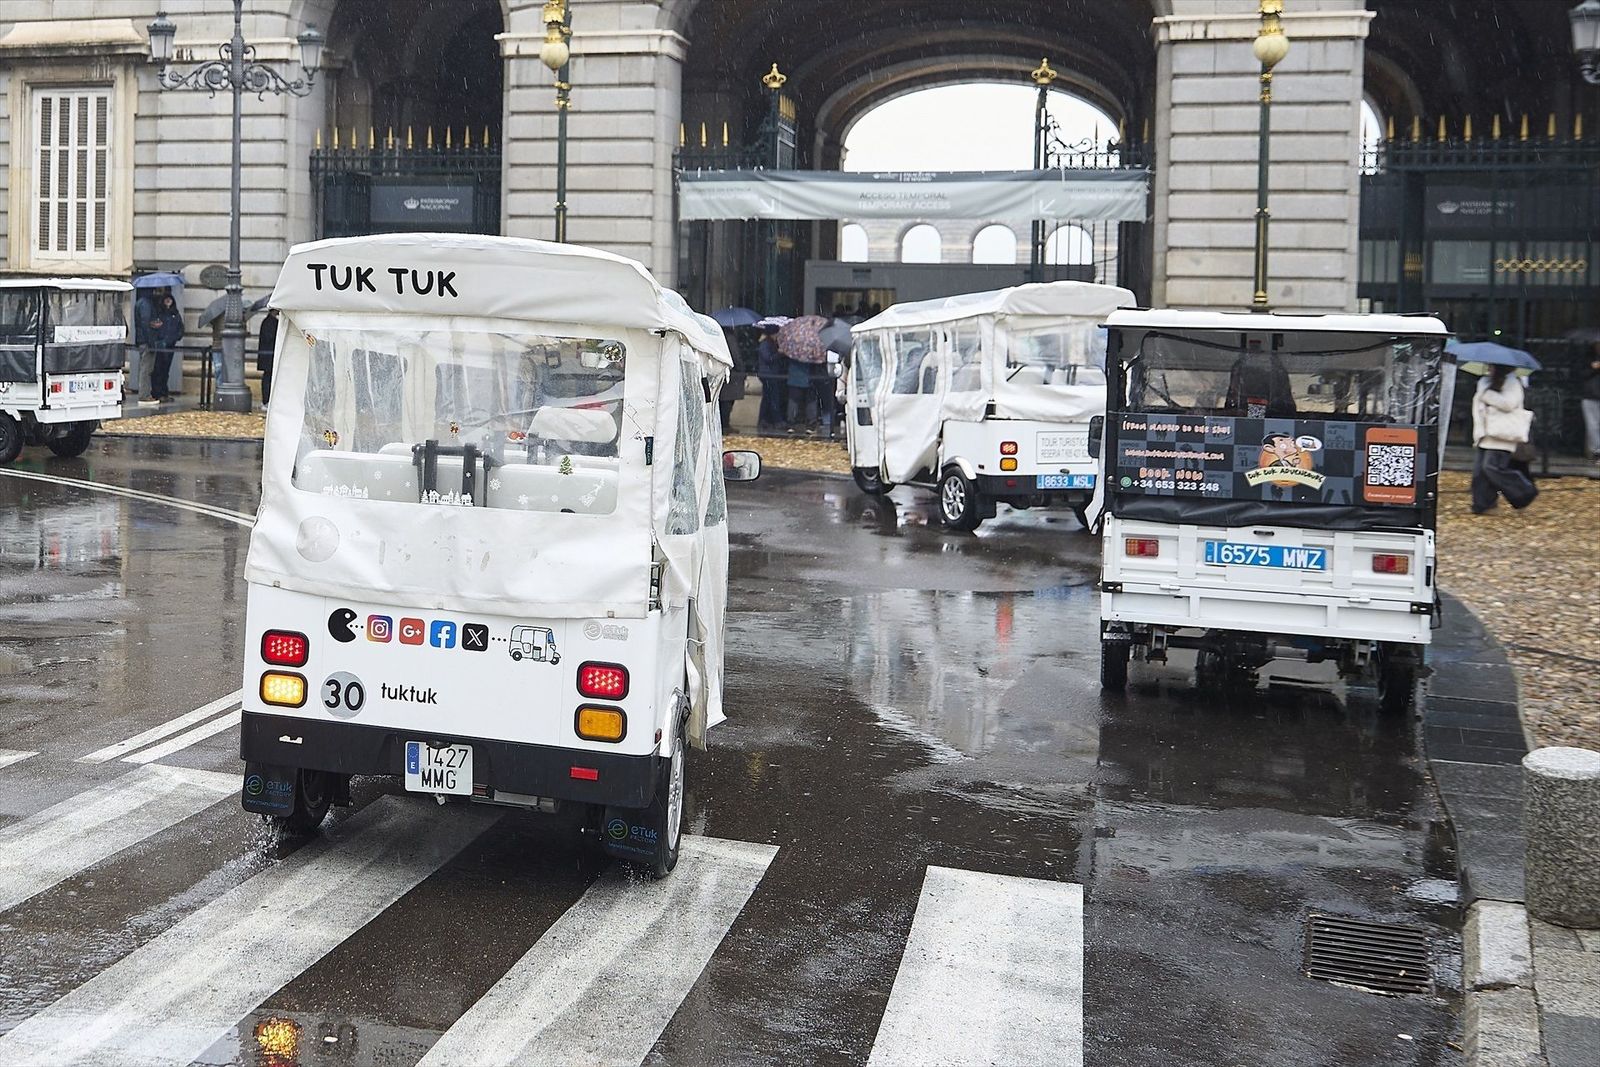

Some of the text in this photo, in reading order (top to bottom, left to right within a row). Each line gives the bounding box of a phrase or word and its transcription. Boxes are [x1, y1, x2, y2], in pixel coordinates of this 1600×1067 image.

[859, 192, 948, 200] ACCESO TEMPORAL
[858, 201, 951, 209] TEMPORARY ACCESS
[307, 263, 458, 298] TUK TUK
[1149, 423, 1180, 432] MADRID
[1041, 437, 1057, 446] TOUR
[1044, 475, 1092, 487] 8633 MSL
[1133, 479, 1219, 492] +34 653 323 248
[1221, 544, 1322, 569] 6575 MWZ
[325, 679, 364, 711] 30
[381, 682, 437, 705] tuktuk
[426, 747, 469, 769] 1427
[421, 768, 456, 789] MMG
[266, 781, 292, 792] eTuk
[631, 825, 657, 839] eTuk
